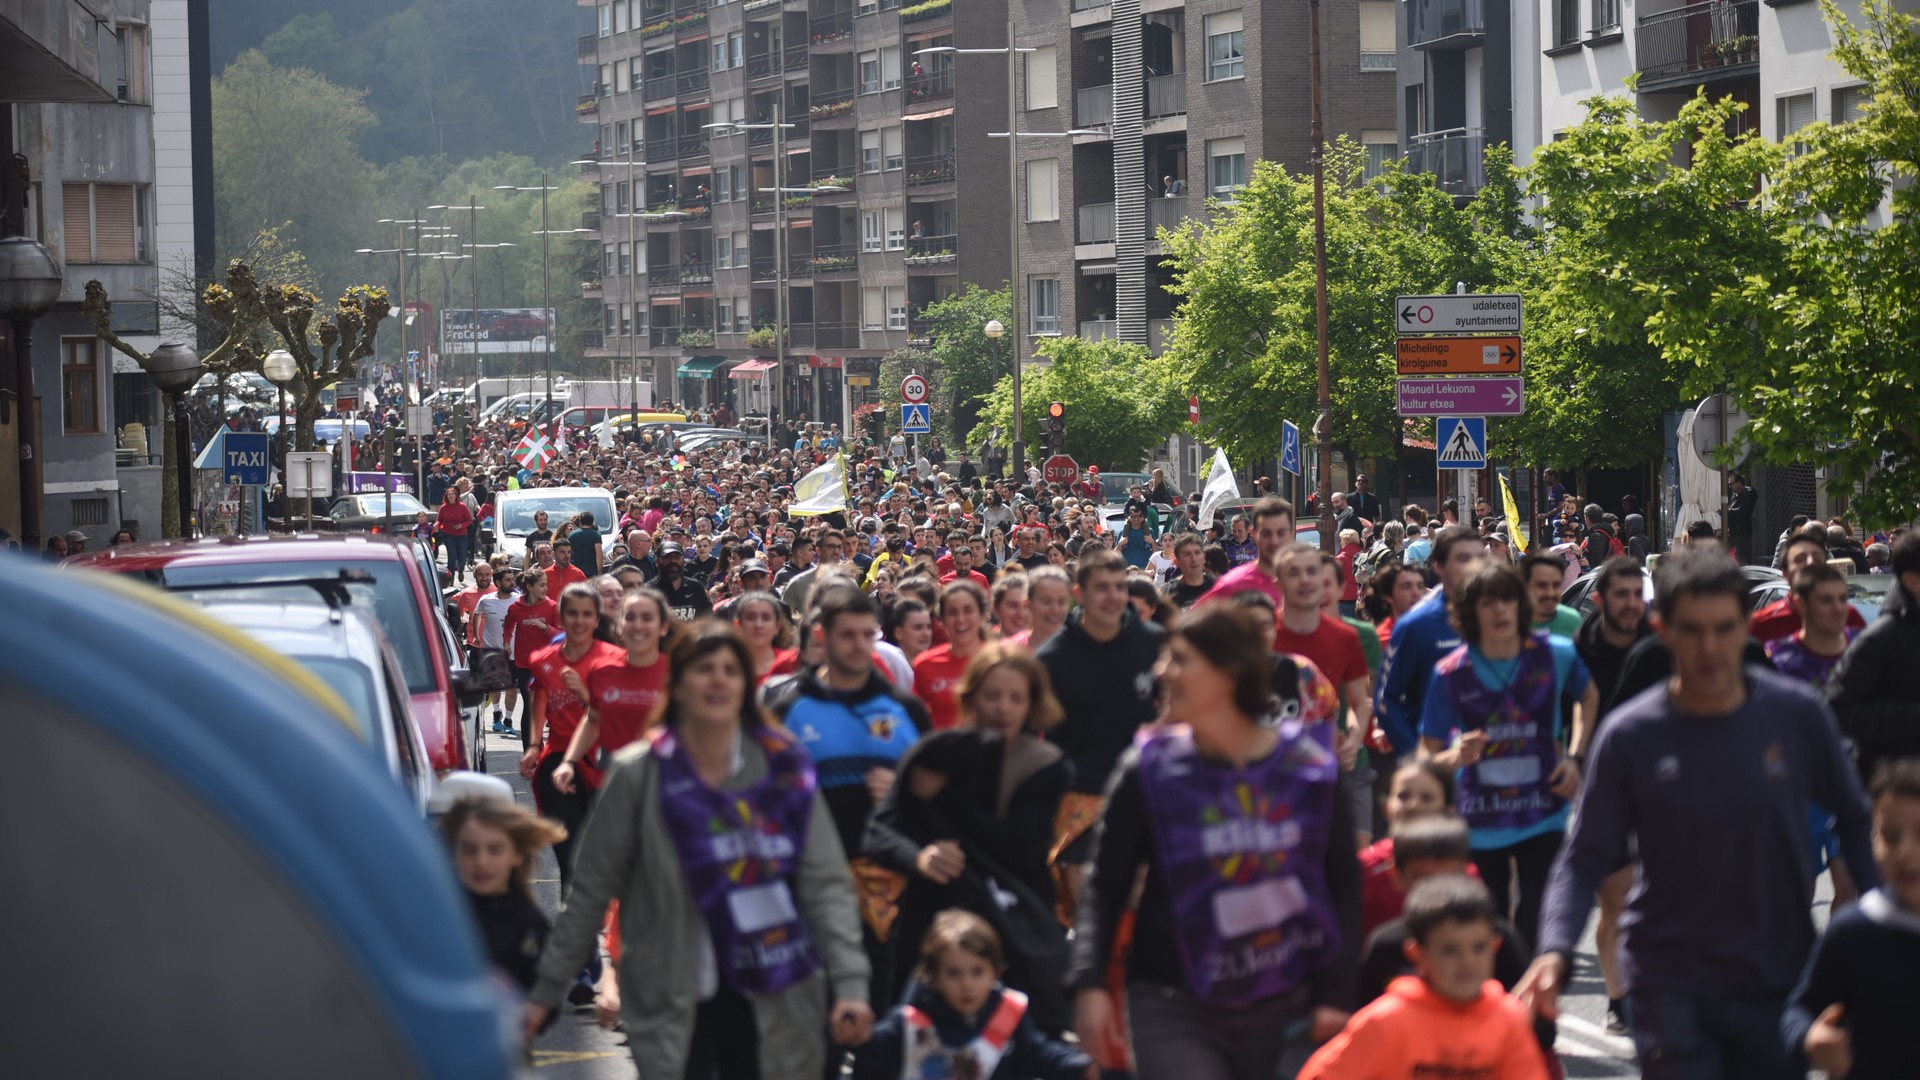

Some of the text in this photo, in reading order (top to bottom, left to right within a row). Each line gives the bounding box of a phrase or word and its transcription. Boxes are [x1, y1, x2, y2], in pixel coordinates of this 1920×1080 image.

[1472, 300, 1518, 311] udaletxea
[1455, 316, 1518, 328] ayuntamiento
[1400, 343, 1450, 354] Michelingo
[1400, 358, 1448, 370] kirolgunea
[908, 385, 923, 395] 30
[1401, 384, 1476, 395] Manuel Lekuona
[1401, 399, 1455, 409] kultur etxea
[228, 451, 265, 467] TAXI
[1047, 467, 1074, 478] STOP
